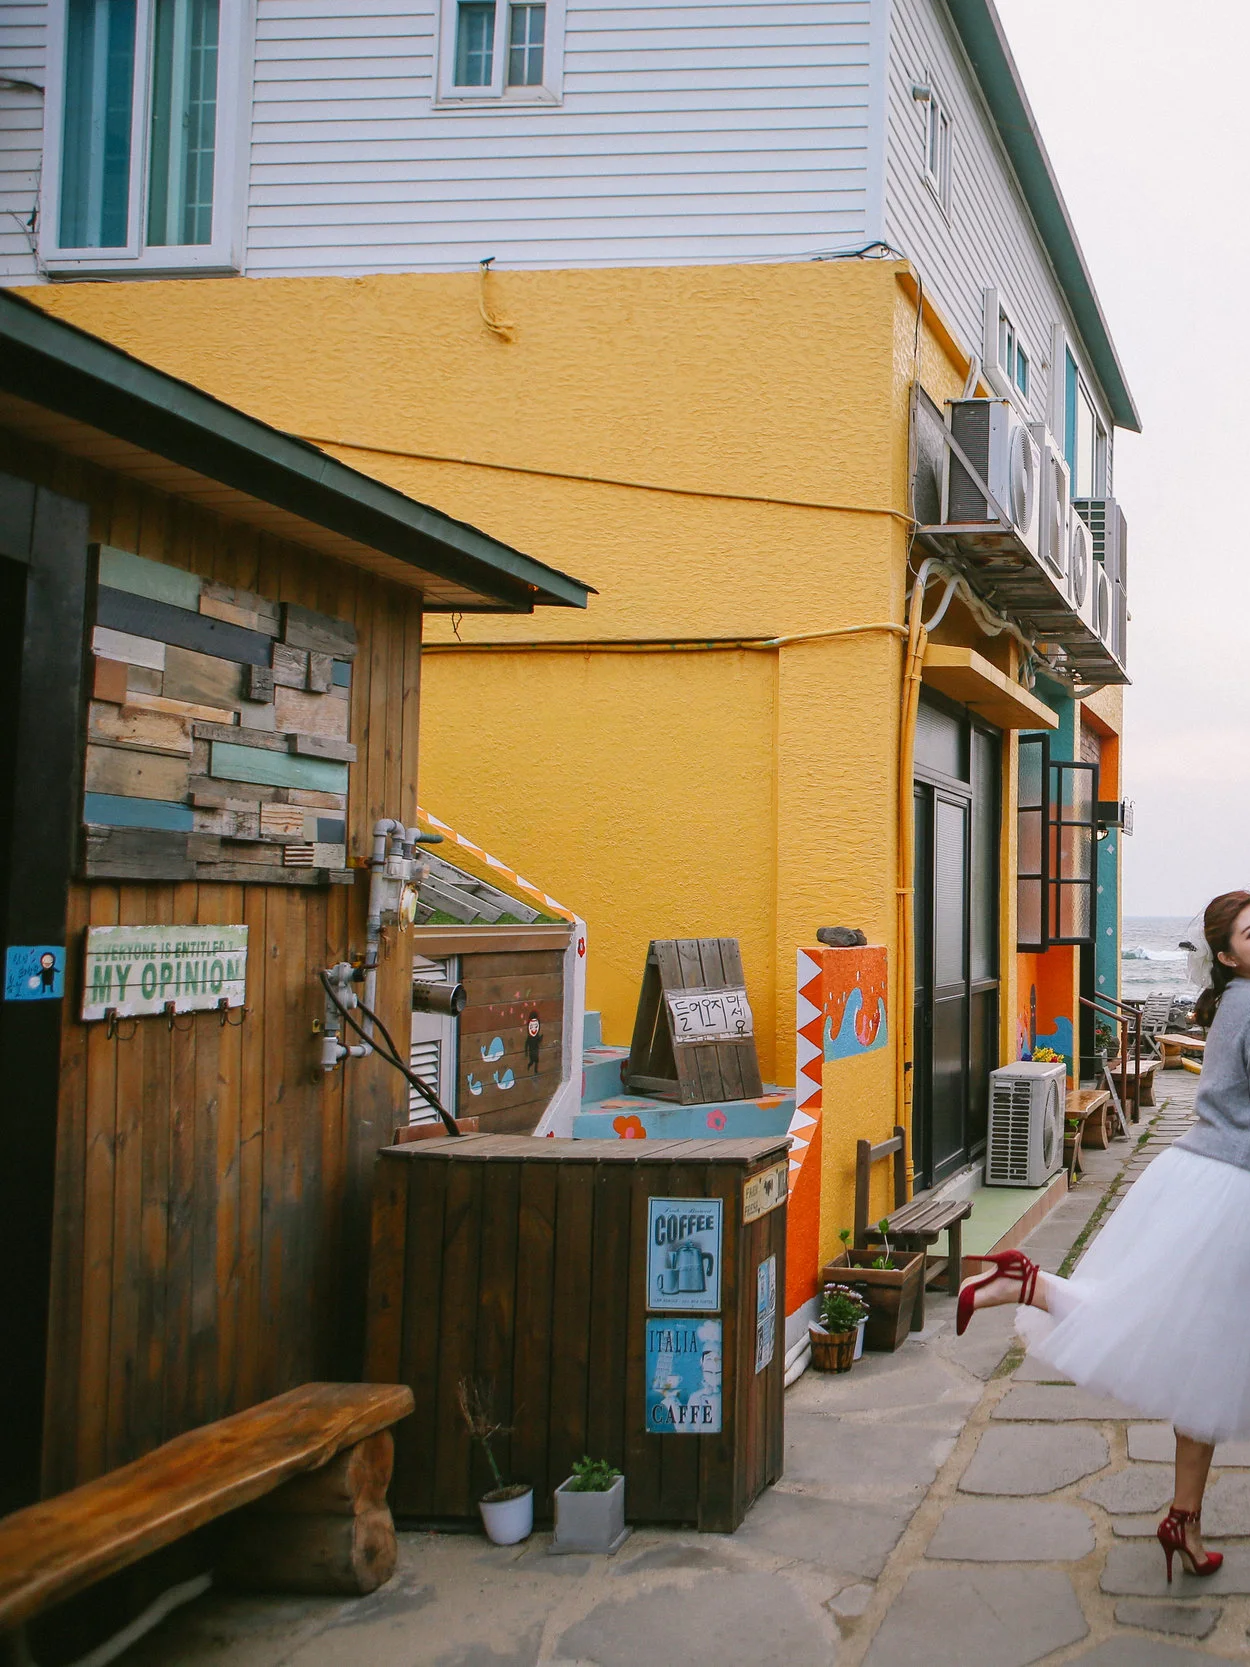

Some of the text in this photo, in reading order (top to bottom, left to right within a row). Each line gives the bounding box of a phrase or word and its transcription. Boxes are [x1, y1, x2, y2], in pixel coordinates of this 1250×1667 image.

[95, 943, 157, 962] EVERYONE
[160, 941, 171, 959] IS
[91, 959, 240, 1003] MY OPINION
[655, 1214, 714, 1246] COFFEE
[649, 1330, 698, 1353] ITALIA
[652, 1399, 713, 1424] CAFFÈ
